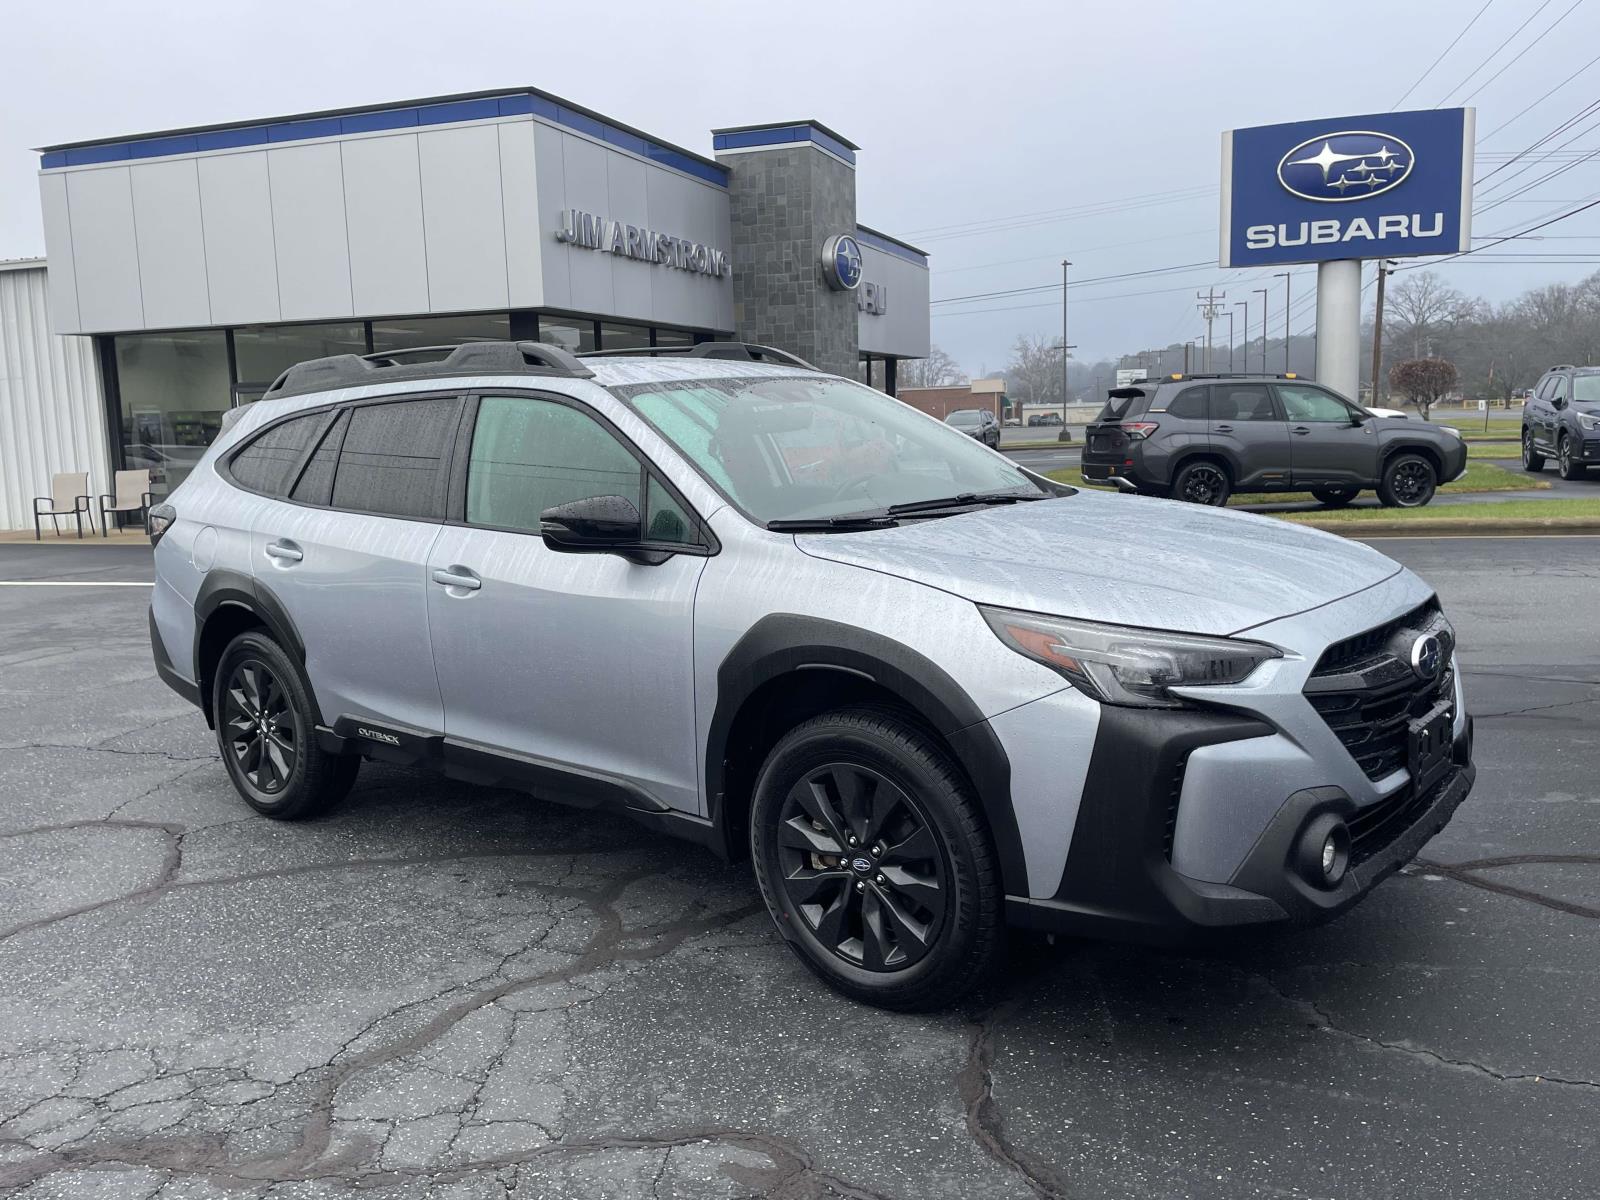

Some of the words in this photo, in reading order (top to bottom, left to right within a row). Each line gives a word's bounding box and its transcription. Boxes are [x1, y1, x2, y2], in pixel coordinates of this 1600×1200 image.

[557, 209, 602, 249] JIM
[605, 222, 731, 277] ARMSTRONG
[1246, 213, 1443, 250] SUBARU
[358, 728, 399, 744] OUTBACK
